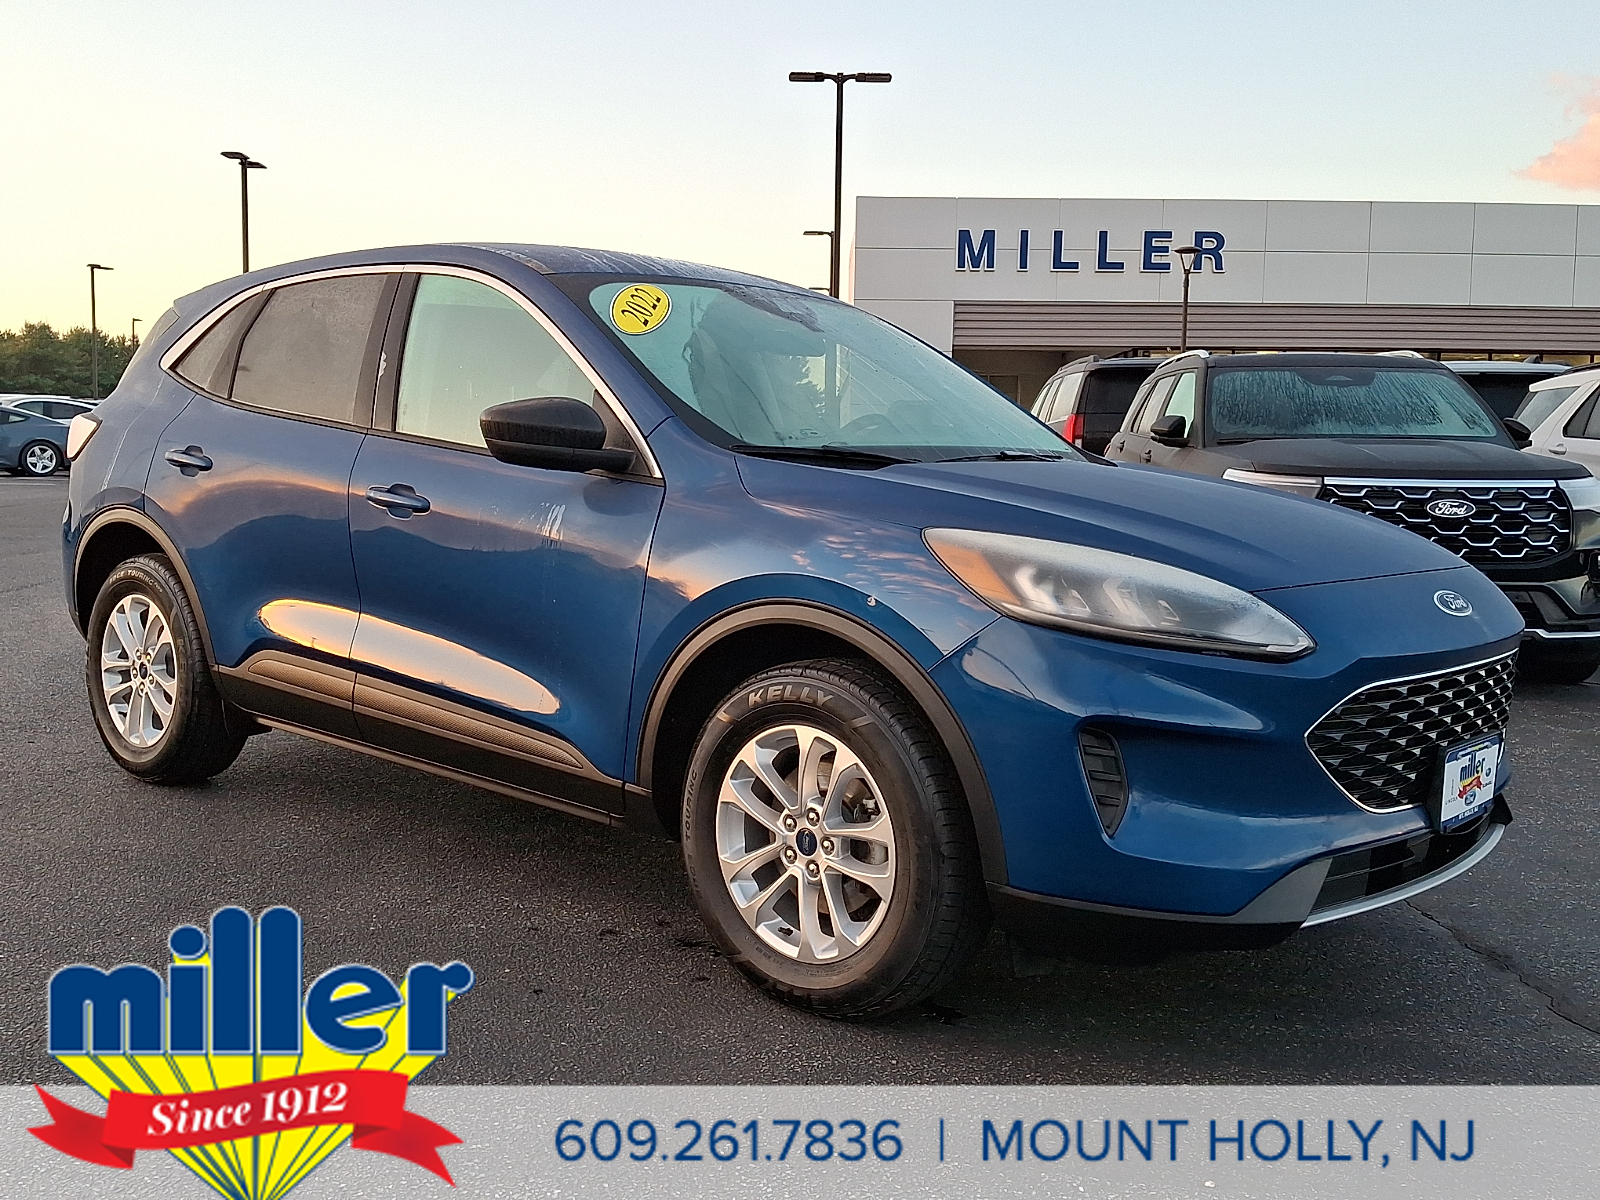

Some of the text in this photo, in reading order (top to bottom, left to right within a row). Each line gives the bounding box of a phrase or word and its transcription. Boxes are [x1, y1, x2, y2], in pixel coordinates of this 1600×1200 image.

[956, 229, 1226, 272] MILLER
[621, 287, 661, 327] 2022
[1435, 501, 1467, 515] Ford
[1443, 594, 1468, 609] Ford
[748, 684, 834, 709] KELLY
[1460, 751, 1486, 782] miller
[685, 769, 698, 842] TOURING
